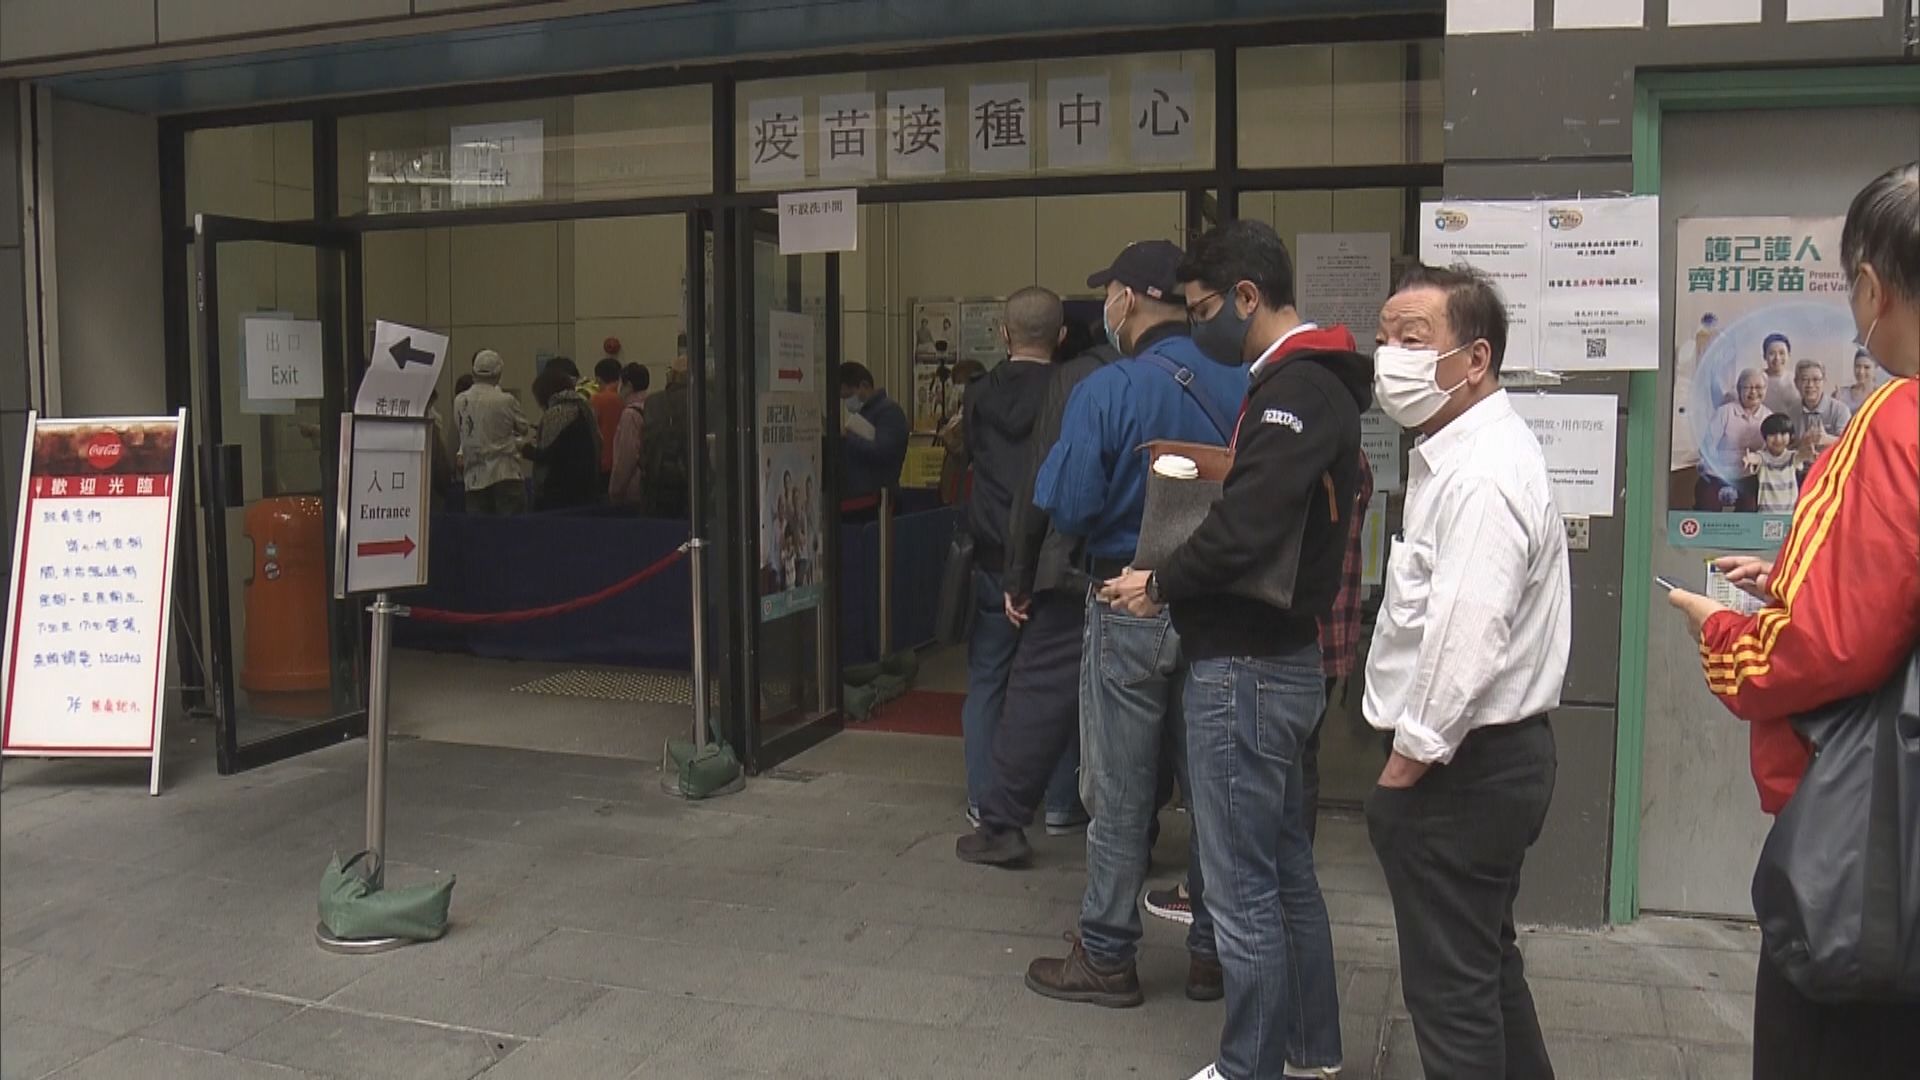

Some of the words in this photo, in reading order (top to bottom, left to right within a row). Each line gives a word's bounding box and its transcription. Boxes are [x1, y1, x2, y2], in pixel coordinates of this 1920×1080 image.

[754, 88, 1190, 164] 疫苗接種中心
[787, 200, 843, 215] 不設洗手間
[1704, 236, 1822, 262] 護己護人
[1688, 267, 1805, 293] 齊打疫苗
[1809, 271, 1840, 279] Protect
[1809, 281, 1828, 291] Get
[265, 332, 300, 353] 出口
[271, 365, 299, 385] Exit
[51, 477, 154, 496] 歡迎光臨
[367, 470, 405, 493] 入口
[360, 504, 411, 521] Entrance
